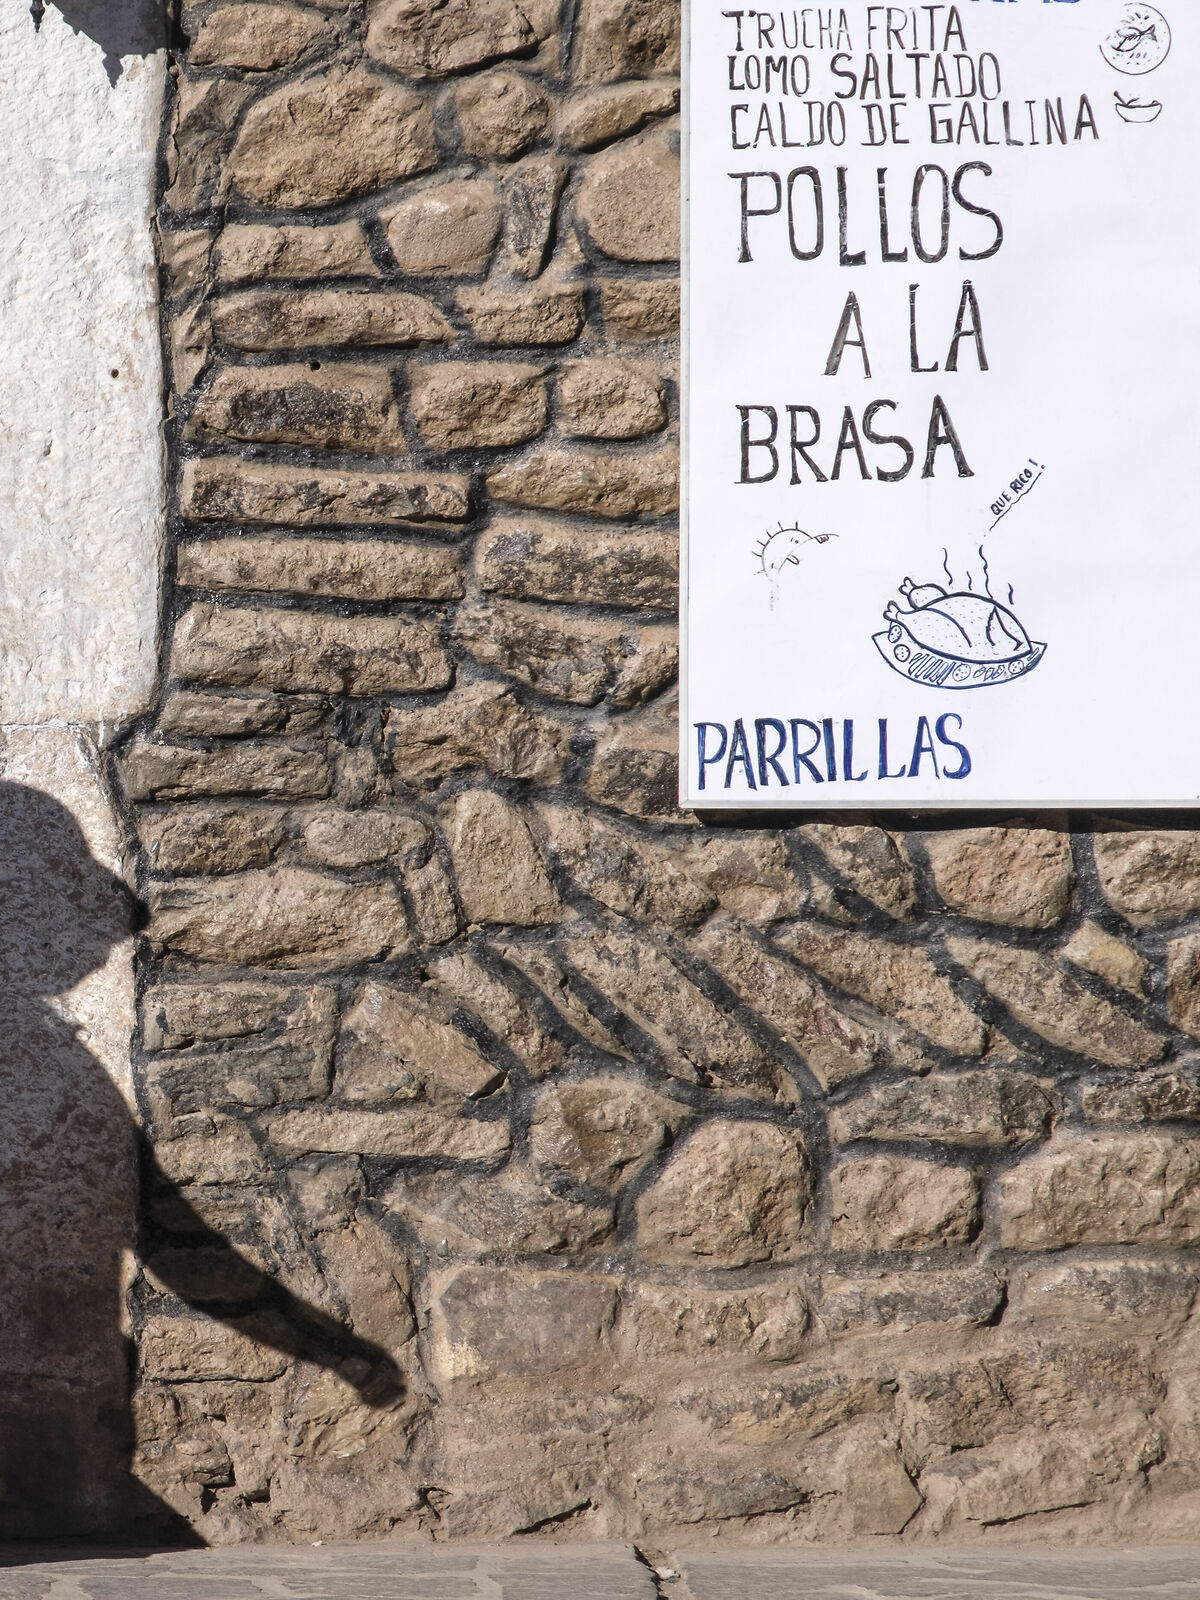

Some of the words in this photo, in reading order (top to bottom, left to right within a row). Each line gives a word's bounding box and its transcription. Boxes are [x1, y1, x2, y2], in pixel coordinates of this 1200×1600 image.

[721, 9, 853, 51] TRUCHA
[867, 5, 968, 51] FRITA
[727, 55, 811, 96] LOMO
[829, 52, 1002, 99] SALTADO
[731, 101, 848, 150] CALDO
[861, 102, 910, 147] DE
[928, 93, 1100, 147] GALLINA
[727, 160, 1004, 267] POLLOS
[821, 290, 872, 379] A
[909, 279, 990, 373] LA
[734, 394, 976, 485] BRASA
[990, 490, 1012, 516] QUE
[692, 712, 972, 791] PARRILLAS
